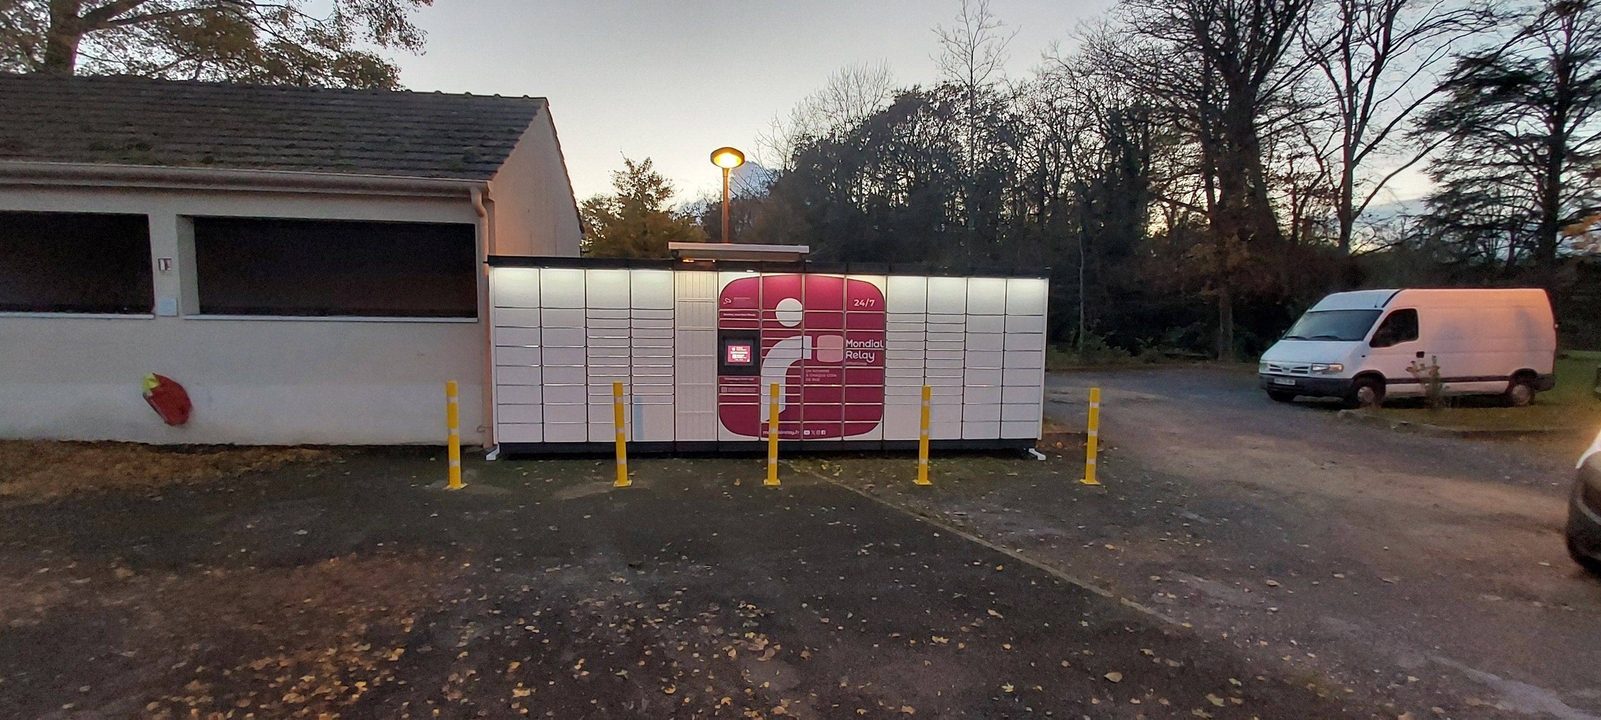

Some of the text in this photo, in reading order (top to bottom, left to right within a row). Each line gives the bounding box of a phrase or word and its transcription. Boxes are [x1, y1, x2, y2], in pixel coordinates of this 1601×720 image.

[854, 298, 875, 307] 24/7
[846, 339, 884, 348] Mondial
[846, 350, 875, 363] Relay
